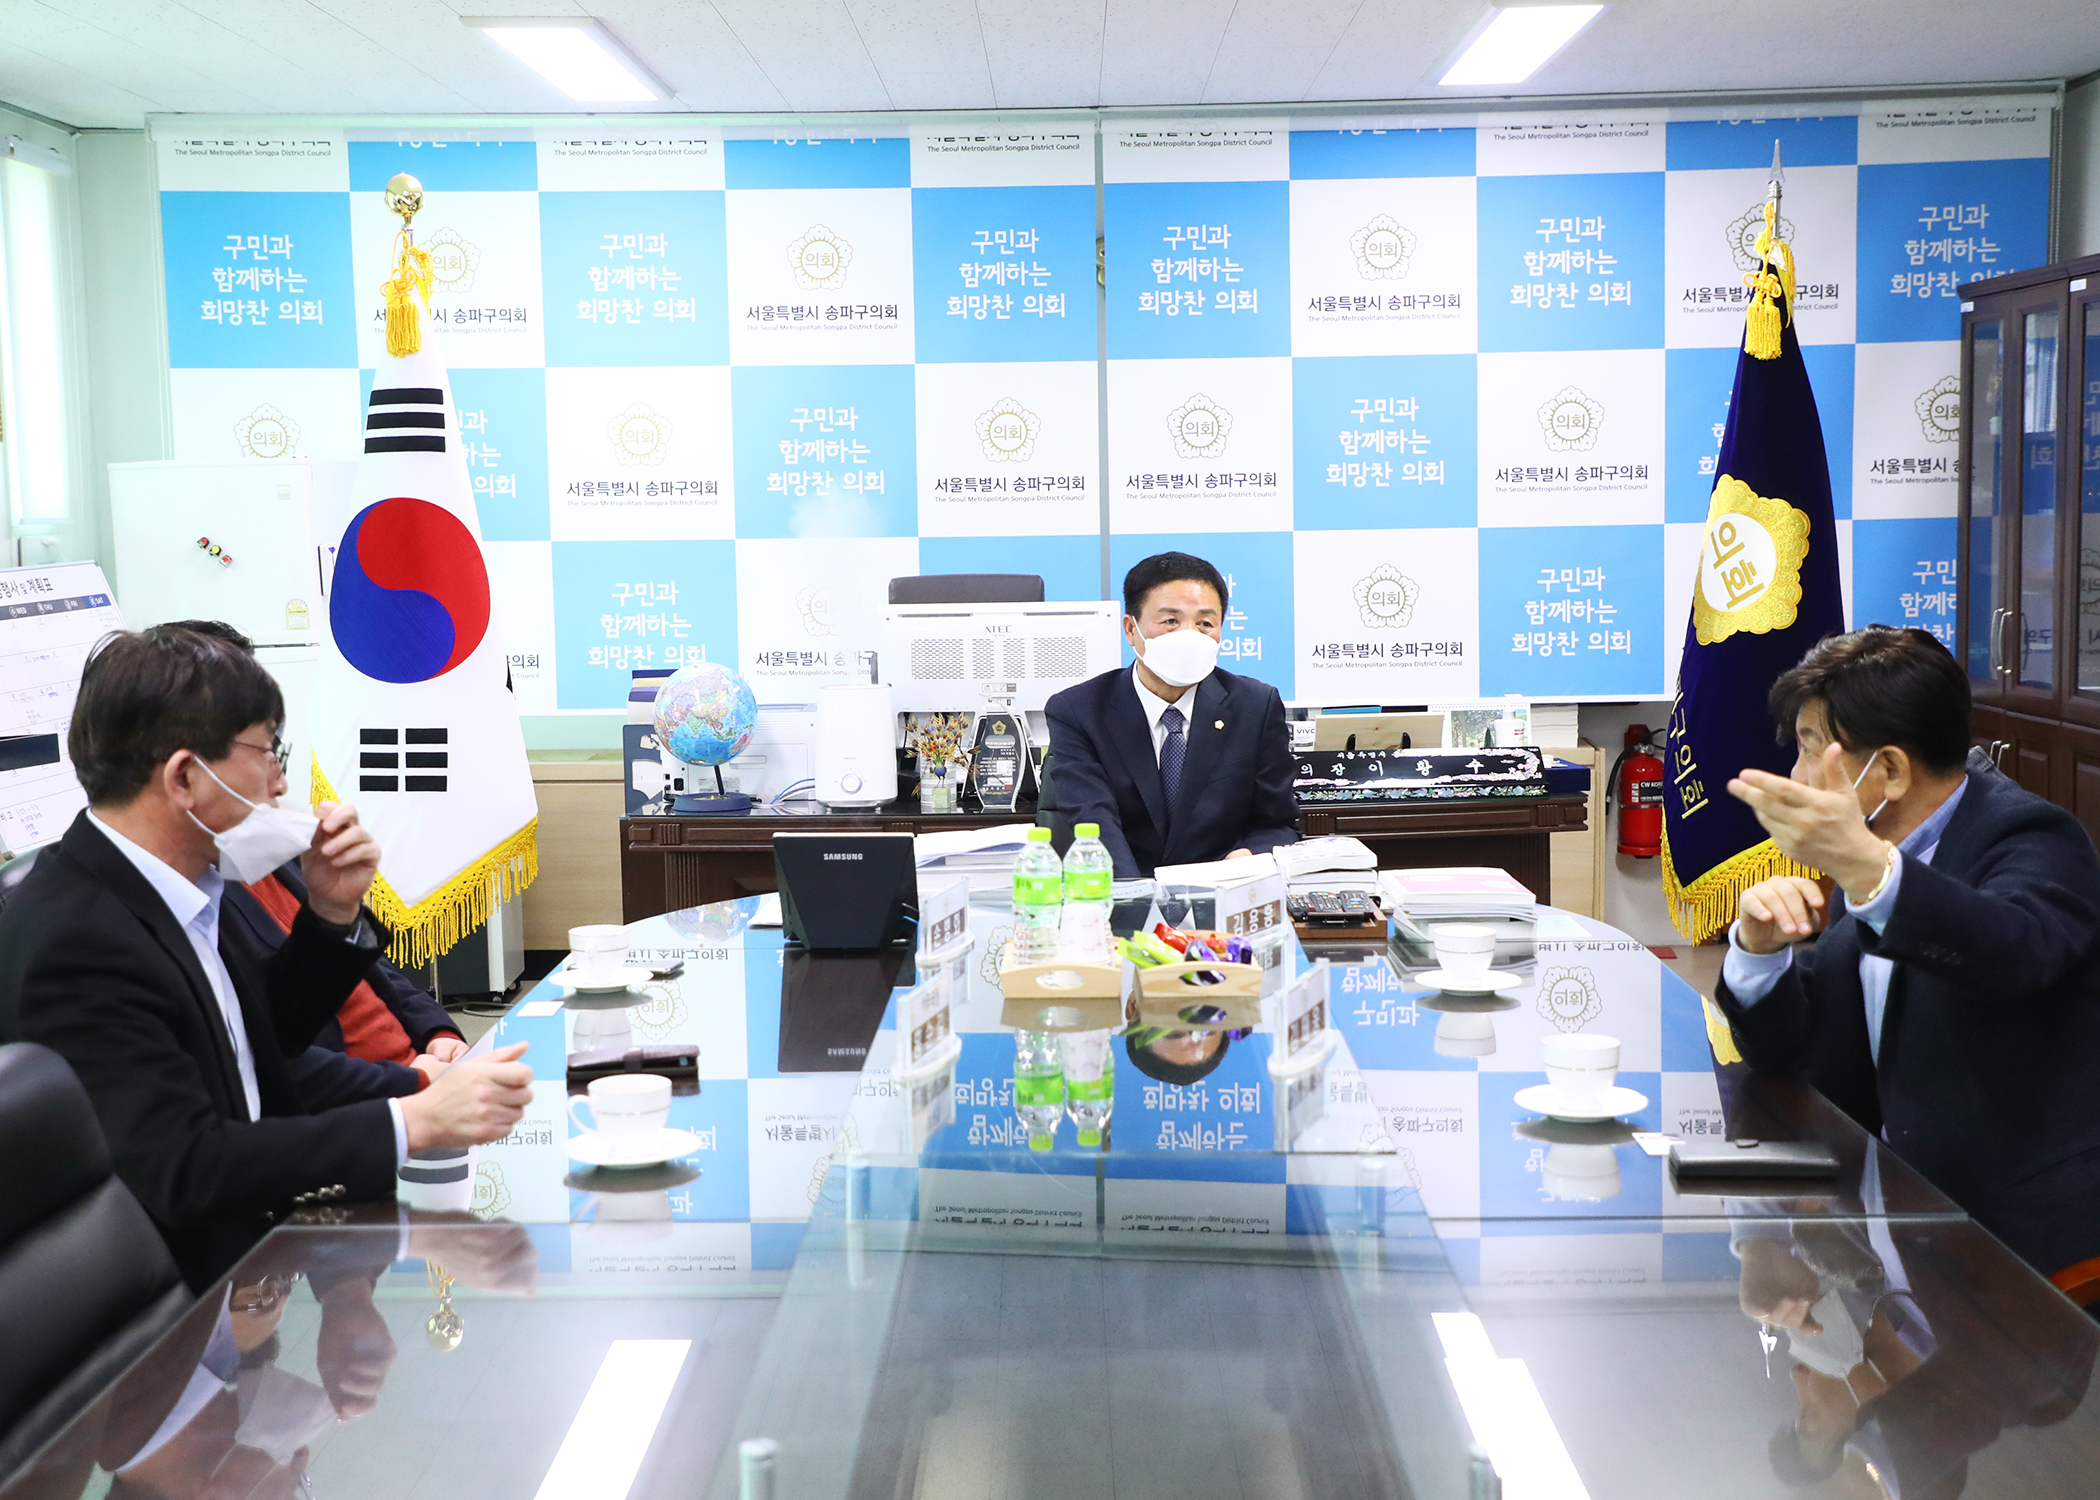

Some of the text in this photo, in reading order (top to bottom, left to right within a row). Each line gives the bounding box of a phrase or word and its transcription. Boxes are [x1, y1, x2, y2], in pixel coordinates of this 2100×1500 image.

[1493, 129, 1649, 141] The Seoul Metropolitan Songpa District Council
[1875, 115, 2037, 129] The Seoul Metropolitan Songpa District Council
[174, 148, 332, 157] The Seoul Metropolitan Songpa District Council
[567, 149, 587, 157] Seoul
[631, 148, 657, 157] Songpa
[658, 148, 682, 156] District
[683, 148, 708, 156] Council
[927, 145, 940, 153] The
[941, 145, 960, 153] Seoul
[960, 144, 1004, 153] Metropolitan
[1004, 144, 1030, 152] Songpa
[1055, 143, 1080, 151] Council
[1133, 140, 1152, 148] Seoul
[1152, 140, 1196, 148] Metropolitan
[1196, 139, 1222, 148] Songpa
[1223, 139, 1247, 147] District
[1248, 138, 1273, 146] Council
[1535, 215, 1606, 244] 구민과
[1918, 203, 1990, 232] 구민과
[223, 234, 295, 261] 구민과
[599, 232, 669, 260] 구민과
[970, 228, 1040, 255] 구민과
[1162, 223, 1232, 251] 구민과
[1368, 242, 1397, 258] 의회
[805, 252, 834, 268] 의회
[1522, 248, 1618, 277] 함께하는
[1904, 237, 2001, 266] 함께하는
[211, 266, 308, 294] 함께하는
[587, 265, 682, 292] 함께하는
[958, 260, 1052, 288] 함께하는
[1150, 256, 1245, 284] 함께하는
[1509, 280, 1632, 310] 희망찬 의회
[1796, 284, 1839, 300] 구의회
[1889, 270, 1961, 299] 희망찬
[200, 299, 324, 326] 희망찬 의회
[453, 307, 528, 324] 송파구의회
[575, 297, 696, 325] 희망찬 의회
[746, 304, 898, 322] 서울특별시 송파구의회
[946, 292, 1066, 321] 희망찬 의회
[1138, 288, 1258, 317] 희망찬 의회
[1308, 293, 1461, 312] 서울특별시 송파구의회
[789, 406, 859, 433] 구민과
[1350, 396, 1420, 423] 구민과
[1556, 414, 1585, 430] 의회
[253, 432, 282, 447] 의회
[625, 429, 654, 445] 의회
[993, 425, 1022, 441] 의회
[1185, 421, 1214, 437] 의회
[1338, 428, 1432, 456] 함께하는
[778, 438, 871, 465] 함께하는
[1325, 459, 1445, 488] 희망찬 의회
[1495, 464, 1648, 483] 서울특별시 송파구의회
[1870, 457, 1947, 475] 서울특별시
[473, 473, 517, 498] 의회
[566, 480, 718, 497] 서울특별시 송파구의회
[766, 469, 885, 498] 희망찬 의회
[934, 475, 1085, 493] 서울특별시 송파구의회
[1125, 472, 1277, 490] 서울특별시 송파구의회
[1710, 520, 1766, 610] 의회
[1912, 559, 1957, 586] 구민
[1536, 566, 1607, 593] 구민과
[611, 580, 680, 607] 구민과
[1371, 591, 1400, 607] 의회
[599, 612, 693, 639] 함께하는
[1524, 598, 1618, 626] 함께하는
[982, 625, 1014, 633] ATEC
[587, 642, 707, 670] 희망찬 의회
[1219, 635, 1262, 661] 의회
[1312, 641, 1463, 659] 서울특별시 송파구의회
[1511, 629, 1631, 657] 희망찬 의회
[755, 650, 827, 667] 서울특별시
[1344, 661, 1387, 669] Metropolitan
[1388, 661, 1413, 669] Songpa
[823, 852, 864, 861] SAMSUNG
